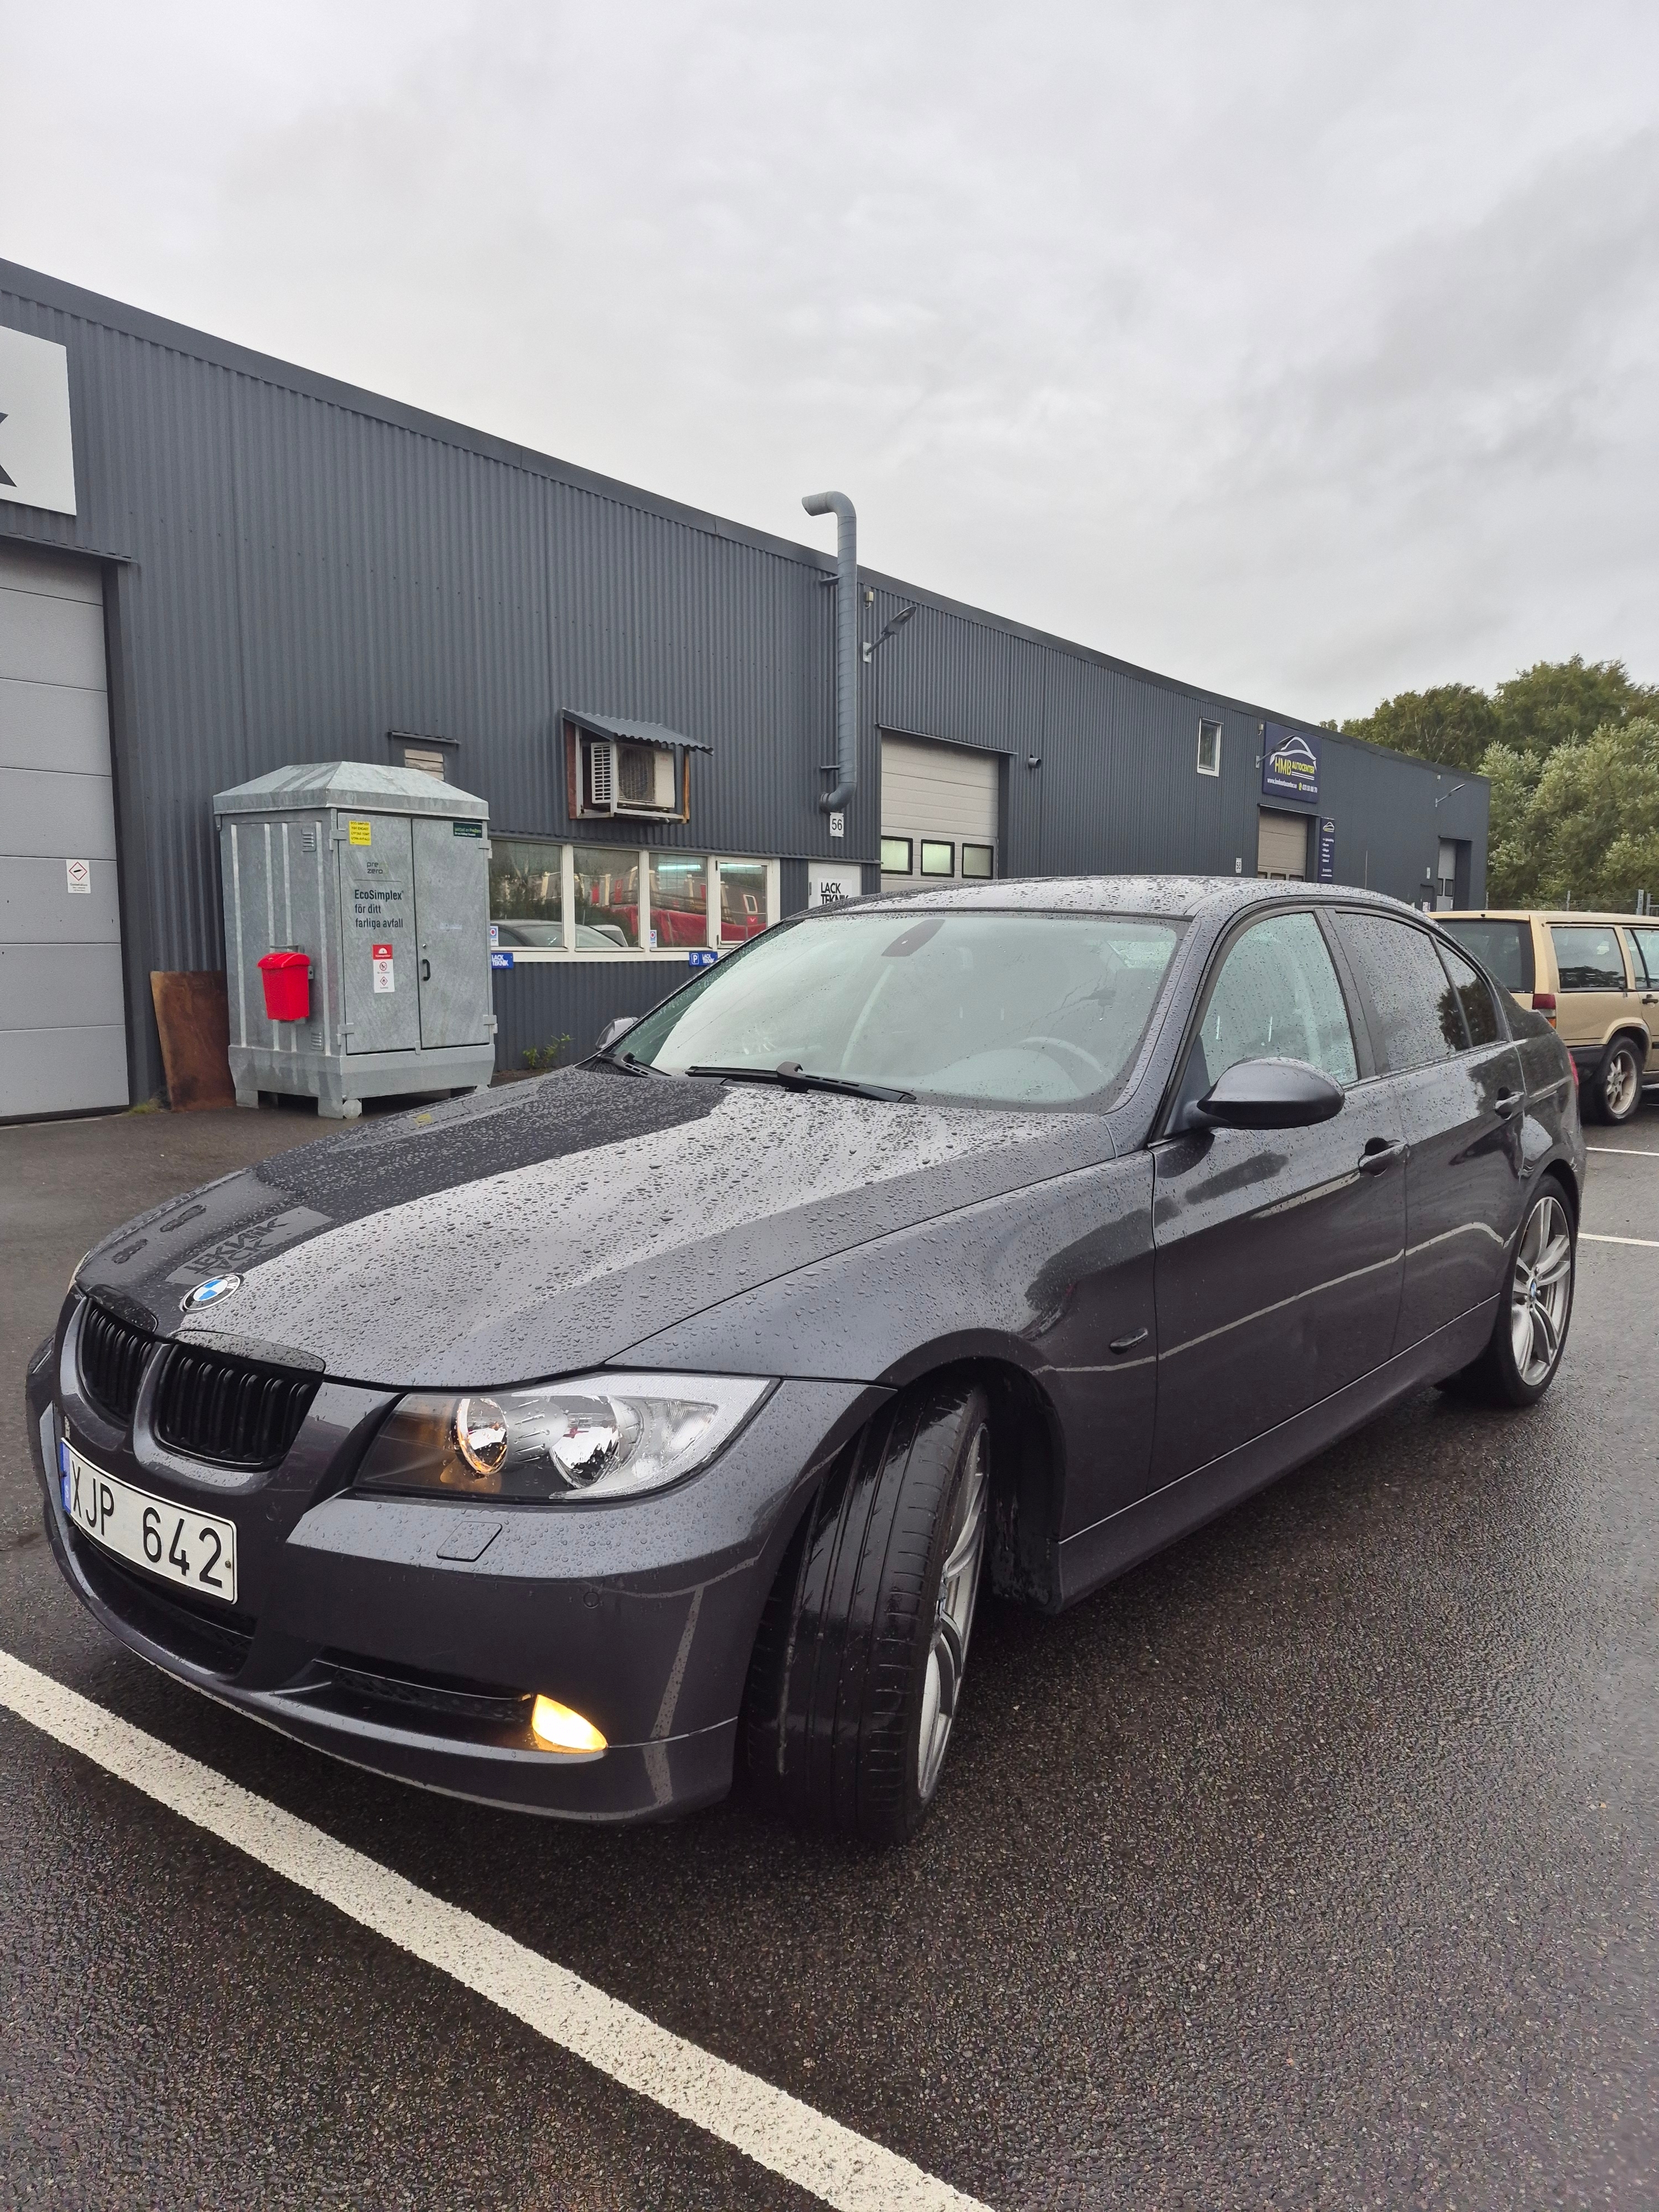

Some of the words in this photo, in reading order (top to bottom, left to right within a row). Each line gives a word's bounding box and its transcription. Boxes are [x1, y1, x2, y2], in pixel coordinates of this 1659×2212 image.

[1275, 757, 1291, 776] HMB
[1292, 761, 1315, 774] AUTOCENTER
[832, 818, 842, 831] 56
[821, 882, 842, 894] LACK
[354, 904, 366, 914] för
[368, 904, 382, 914] ditt
[356, 918, 381, 930] farliga
[383, 918, 403, 928] avfall
[72, 1460, 114, 1536] XJP
[143, 1507, 223, 1589] 642
